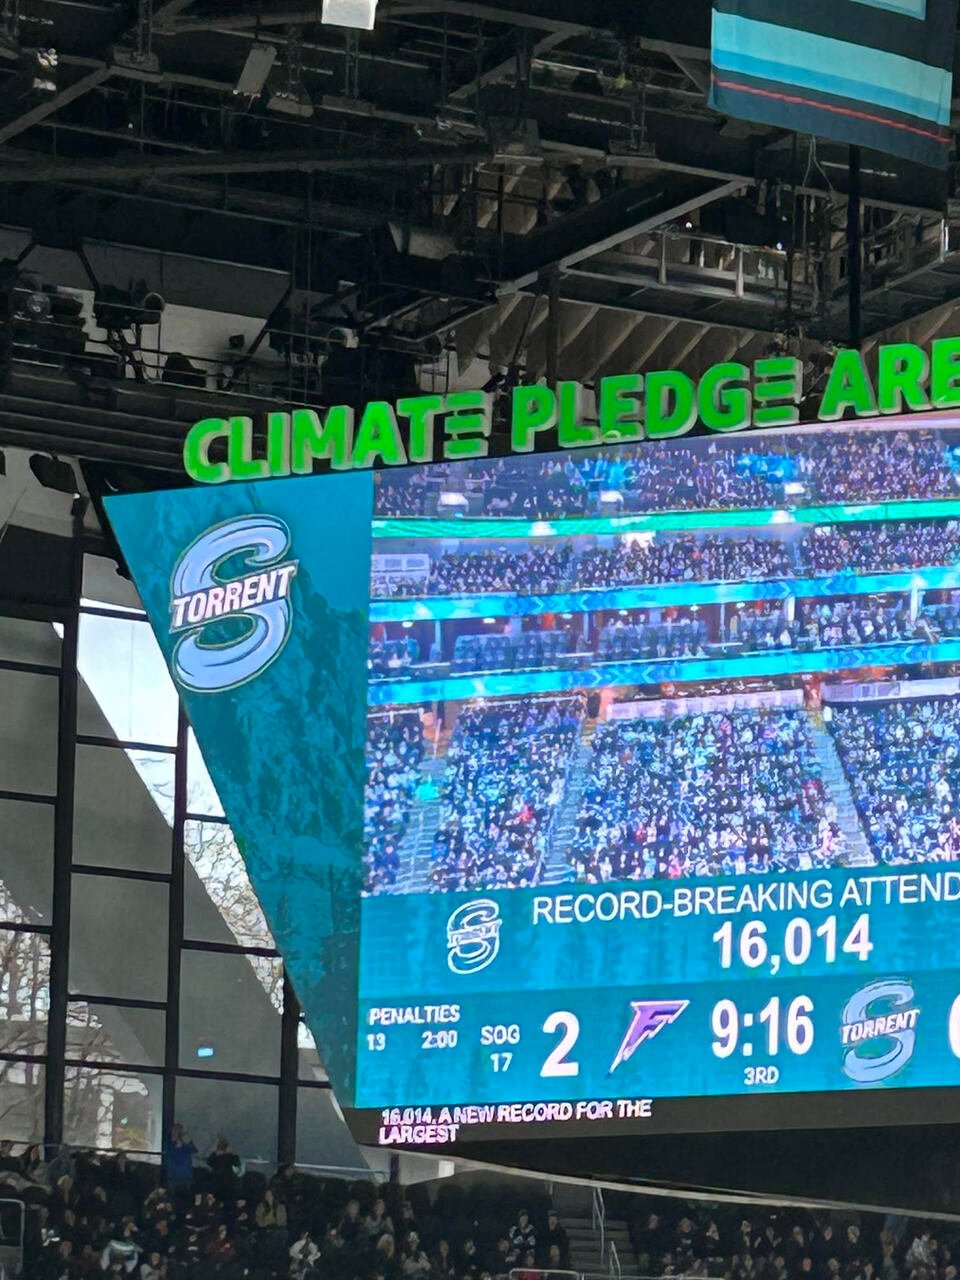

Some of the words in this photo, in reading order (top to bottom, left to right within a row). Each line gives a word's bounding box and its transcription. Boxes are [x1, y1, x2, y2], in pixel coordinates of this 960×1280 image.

[183, 390, 493, 484] CLIMATE
[511, 357, 801, 452] PLEDGE
[172, 564, 298, 629] TORRENT
[532, 879, 833, 925] RECORD-BREAKING
[713, 913, 874, 975] 16,014
[367, 1004, 461, 1026] PENALTIES
[711, 995, 815, 1059] 9:16
[841, 1008, 921, 1045] TORRENT
[421, 1030, 458, 1050] 2:00
[480, 1025, 521, 1046] SOG
[540, 1010, 580, 1078] 2
[490, 1052, 513, 1073] 17
[743, 1066, 780, 1086] 3RD
[438, 1106, 453, 1125] A
[453, 1104, 495, 1124] NEW
[497, 1101, 573, 1122] RECORD
[575, 1100, 613, 1120] FOR
[617, 1098, 653, 1118] THE
[378, 1124, 460, 1145] LARGEST
